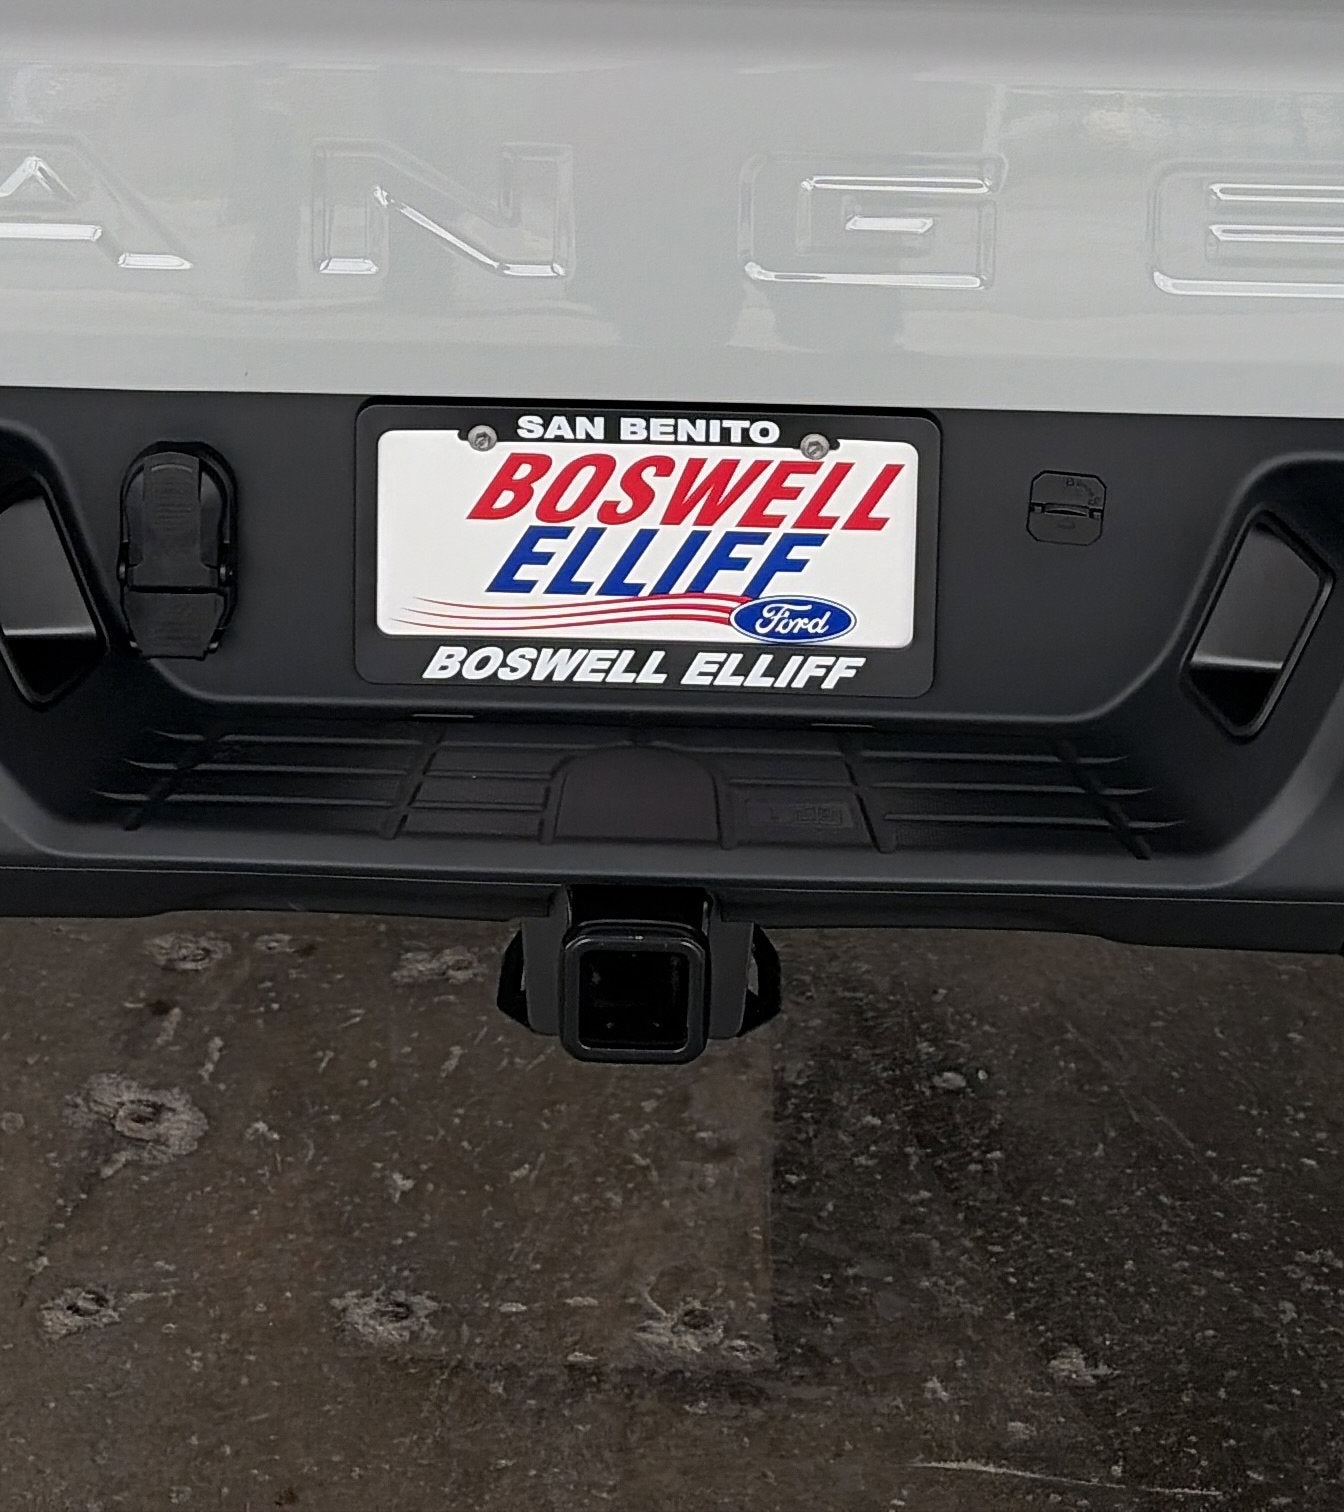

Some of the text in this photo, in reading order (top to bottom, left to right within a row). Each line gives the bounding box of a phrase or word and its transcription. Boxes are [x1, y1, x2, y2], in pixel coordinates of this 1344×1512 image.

[516, 415, 780, 444] SAN BENITO
[466, 452, 905, 531] BOSWELL
[484, 525, 831, 597] ELLIFF
[754, 603, 830, 636] Ford
[422, 645, 865, 690] BOSWELL ELLIFF
